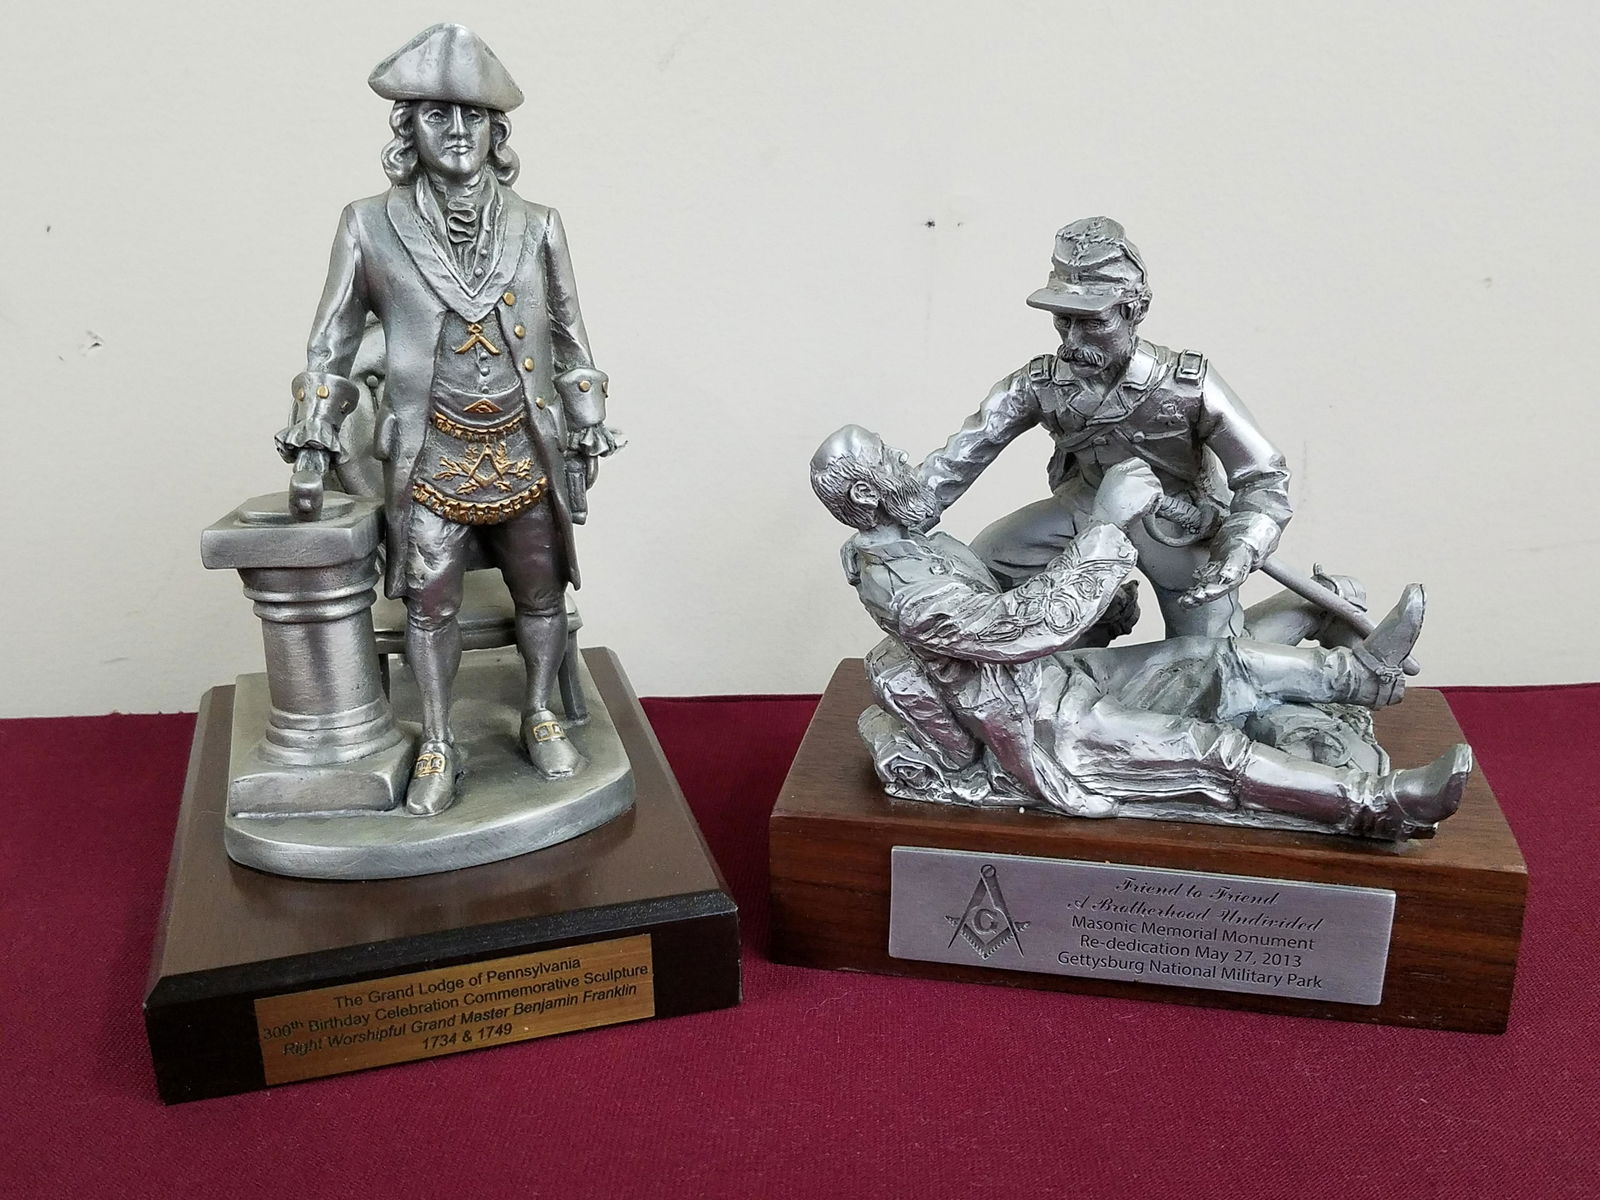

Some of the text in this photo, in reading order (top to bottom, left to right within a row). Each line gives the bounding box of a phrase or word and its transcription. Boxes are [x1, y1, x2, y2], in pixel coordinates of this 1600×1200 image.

[1115, 877, 1280, 905] Friend to Friend
[1067, 896, 1324, 931] A Brotherhood Undivided
[1071, 915, 1315, 950] Masonic Memorial Monument
[1080, 934, 1302, 968] Re-dedication May 27, 2013
[334, 957, 581, 1009] The Grand Lodge of Pennsylvania
[1058, 951, 1323, 988] Gettysburg National Military Park
[308, 1013, 370, 1032] Birthday
[375, 998, 459, 1021] Celebration
[464, 975, 579, 1005] Commemorative
[584, 965, 648, 984] Sculpture
[283, 984, 637, 1057] Right Worshipful Grand Master Benjamin Franklin
[422, 1022, 512, 1050] 1734 & 1749
